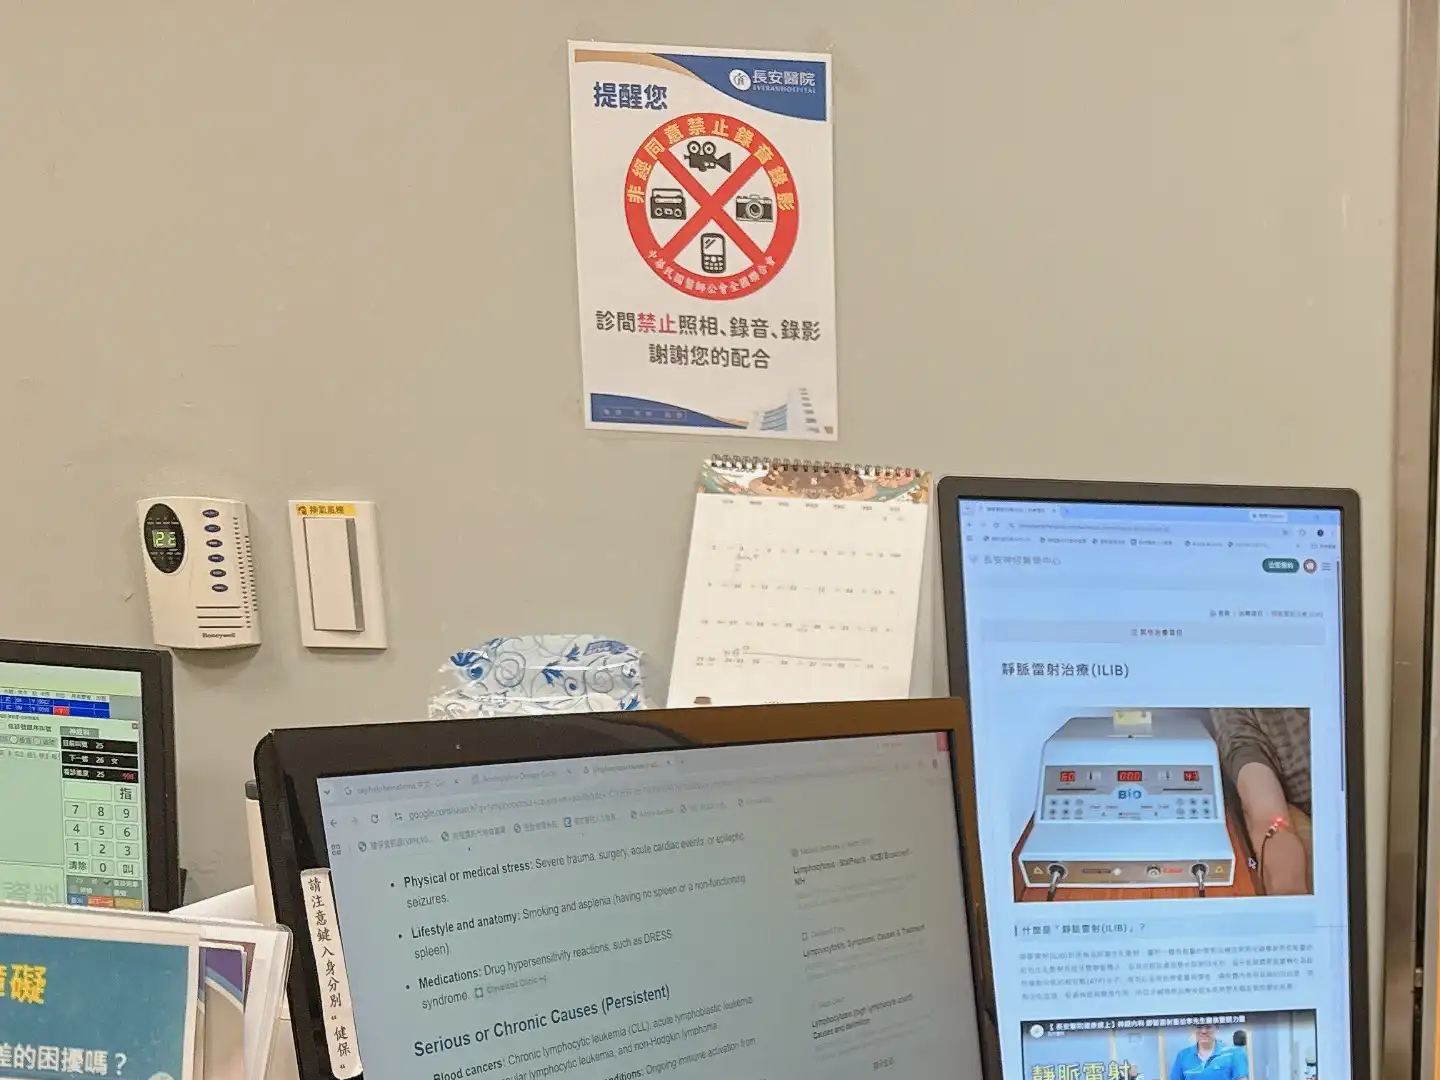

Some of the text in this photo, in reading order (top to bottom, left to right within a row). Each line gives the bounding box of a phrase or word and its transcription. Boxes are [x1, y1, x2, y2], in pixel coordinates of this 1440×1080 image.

[752, 69, 815, 86] 長安醫院
[593, 81, 668, 110] 提醒您
[596, 311, 820, 342] 診間禁止照相、錄音、錄影
[648, 343, 771, 370] 謝謝您的配合
[1001, 662, 1130, 679] 靜脈雷射治療(ILIB)
[96, 770, 105, 778] 25
[119, 786, 133, 801] 指
[72, 805, 79, 815] 7
[97, 806, 105, 817] 8
[123, 808, 131, 819] 9
[72, 823, 81, 834] 4
[98, 825, 105, 836] 5
[123, 826, 131, 838] 6
[99, 862, 107, 873] 0
[403, 871, 447, 890] Physical
[449, 871, 460, 881] or
[462, 863, 500, 879] medical
[501, 860, 533, 874] stress:
[534, 855, 565, 869] Severe
[410, 919, 454, 940] Lifestyle
[455, 917, 475, 931] and
[476, 911, 520, 929] anatomy:
[522, 903, 559, 921] Smoking
[560, 901, 576, 913] and
[417, 965, 482, 990] Medications:
[483, 961, 506, 977] Drug
[506, 948, 571, 973] hypersensitivity
[612, 937, 631, 949] such
[632, 937, 642, 945] as
[643, 928, 673, 944] DRESS
[412, 983, 670, 1057] Serious or Chronic Causes (Persistent)
[464, 1057, 506, 1077] cancers:
[507, 1047, 541, 1065] Chronic
[542, 1034, 591, 1058] lymphocytic
[591, 1025, 626, 1044] leukemia
[674, 1001, 722, 1024] lymphoblastic
[527, 1057, 577, 1080] lymphocytic
[618, 1043, 632, 1055] and
[633, 1030, 680, 1052] non-Hodgkin
[645, 1056, 677, 1076] Ongoing
